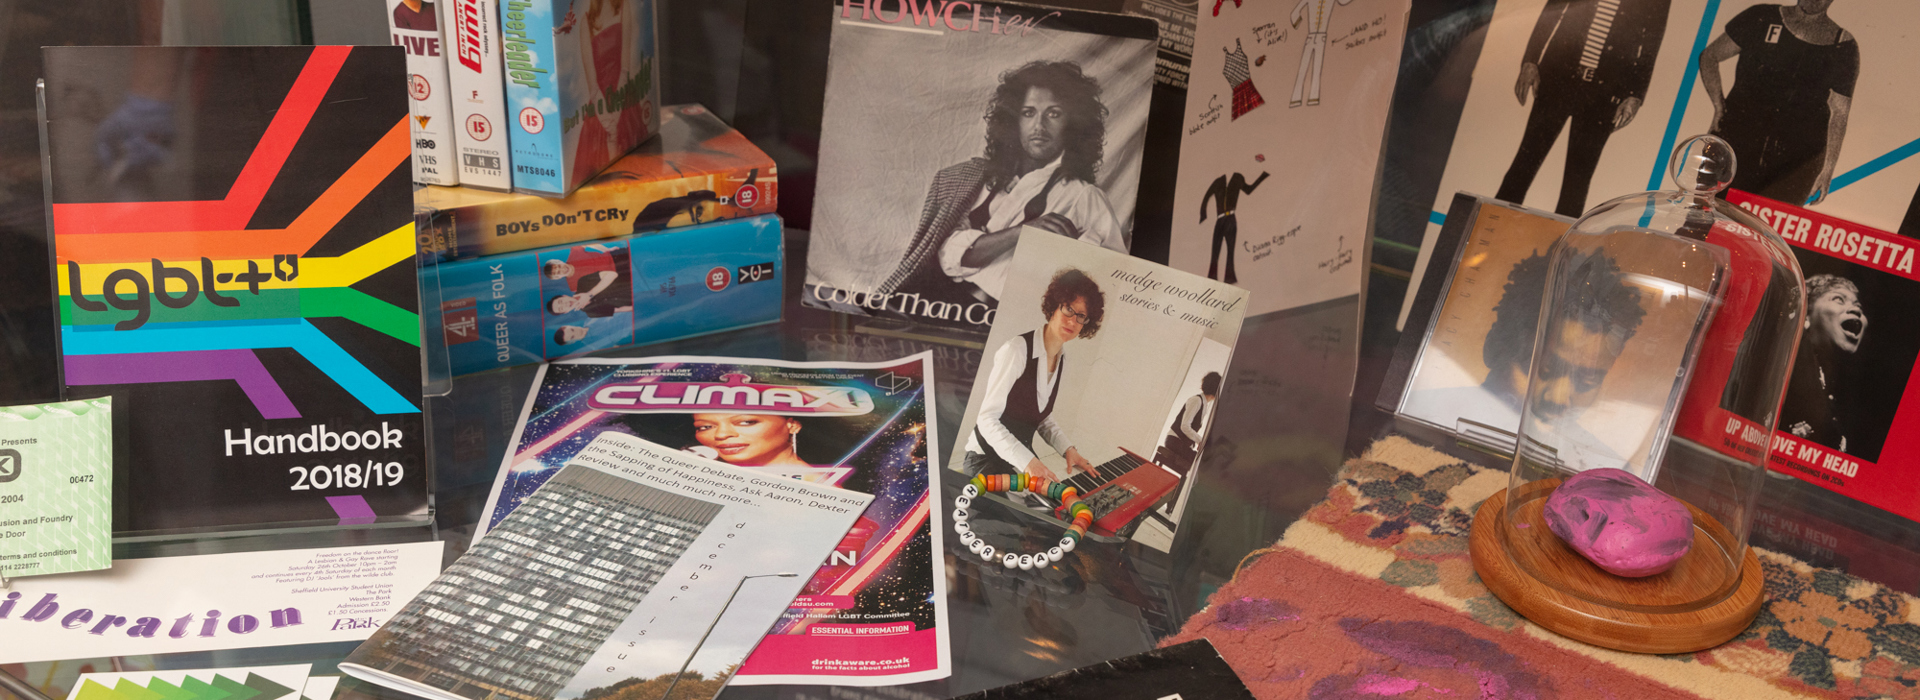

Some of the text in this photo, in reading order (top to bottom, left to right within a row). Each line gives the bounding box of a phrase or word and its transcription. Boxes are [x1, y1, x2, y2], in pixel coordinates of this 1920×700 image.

[505, 0, 548, 88] heerleader
[1768, 26, 1780, 41] F
[474, 122, 484, 133] 15
[526, 115, 538, 126] 15
[517, 165, 555, 177] MTS8046
[742, 190, 753, 203] 18
[1460, 213, 1500, 298] CHAMAN
[1814, 223, 1915, 274] ROSETTA
[712, 272, 724, 286] 18
[1111, 268, 1242, 313] madge woollard
[490, 264, 510, 362] QUEER AS FOLK
[814, 281, 962, 322] Colder Than
[1120, 292, 1220, 329] stories & music
[1, 437, 38, 446] Presents
[224, 421, 403, 457] Handbook
[1725, 417, 1742, 435] UP
[1798, 445, 1822, 464] MY
[1822, 454, 1859, 478] HEAD
[70, 475, 94, 484] 00472
[289, 460, 405, 491] 2018/19
[578, 454, 761, 508] Review and much much more...
[588, 445, 851, 515] the Sapping of Happiness, Ask Aaron, Dexter
[597, 437, 865, 507] Inside: The Queer Debate, Gordon Brown and
[1821, 472, 1829, 481] ON
[1, 494, 24, 504] 2004
[40, 515, 73, 524] Foundry
[14, 562, 40, 570] 2228777
[39, 549, 77, 558] conditions
[670, 522, 746, 602] december
[1004, 538, 1070, 566] PEACE
[856, 625, 909, 634] INFORMATION
[606, 616, 656, 673] issue
[812, 657, 910, 665] drinkaware.co.uk
